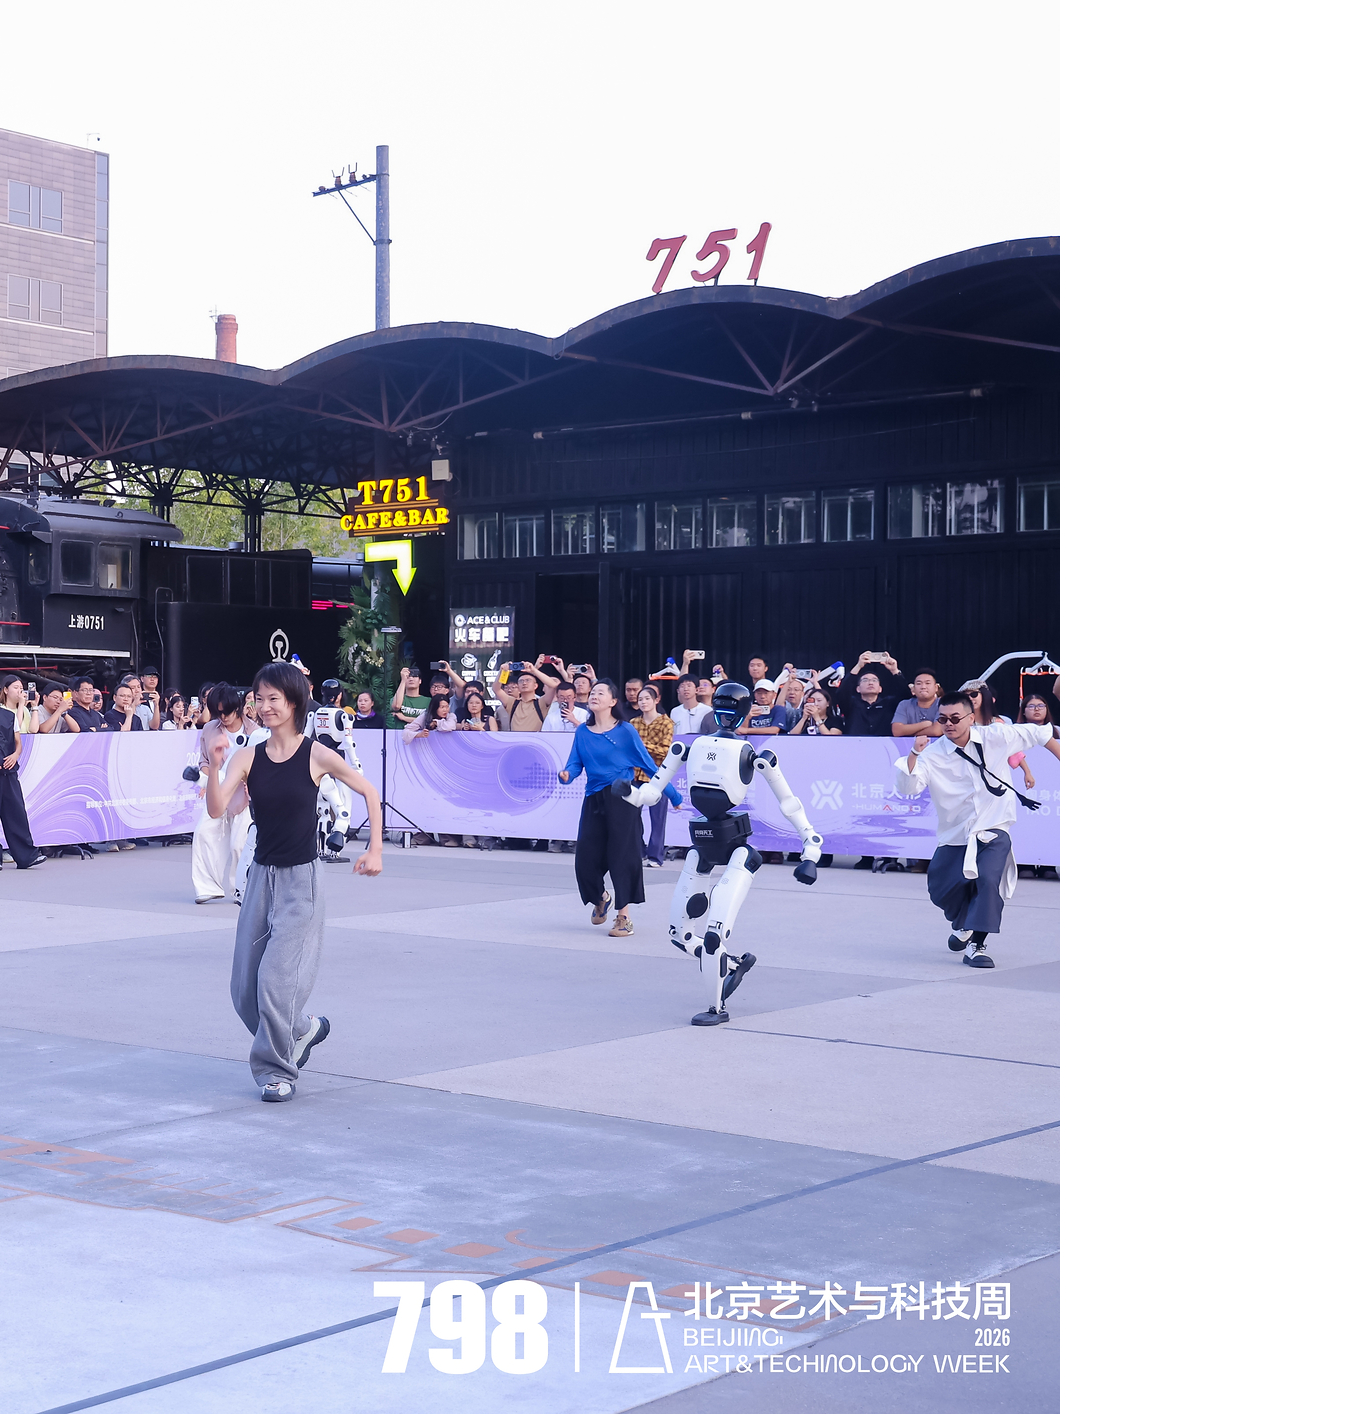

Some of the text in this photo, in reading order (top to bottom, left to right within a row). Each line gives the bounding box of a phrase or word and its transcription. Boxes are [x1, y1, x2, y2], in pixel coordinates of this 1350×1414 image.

[645, 221, 773, 294] 751
[357, 475, 430, 505] T751
[339, 507, 450, 531] CAFE&BAR
[68, 614, 104, 630] 上游0751
